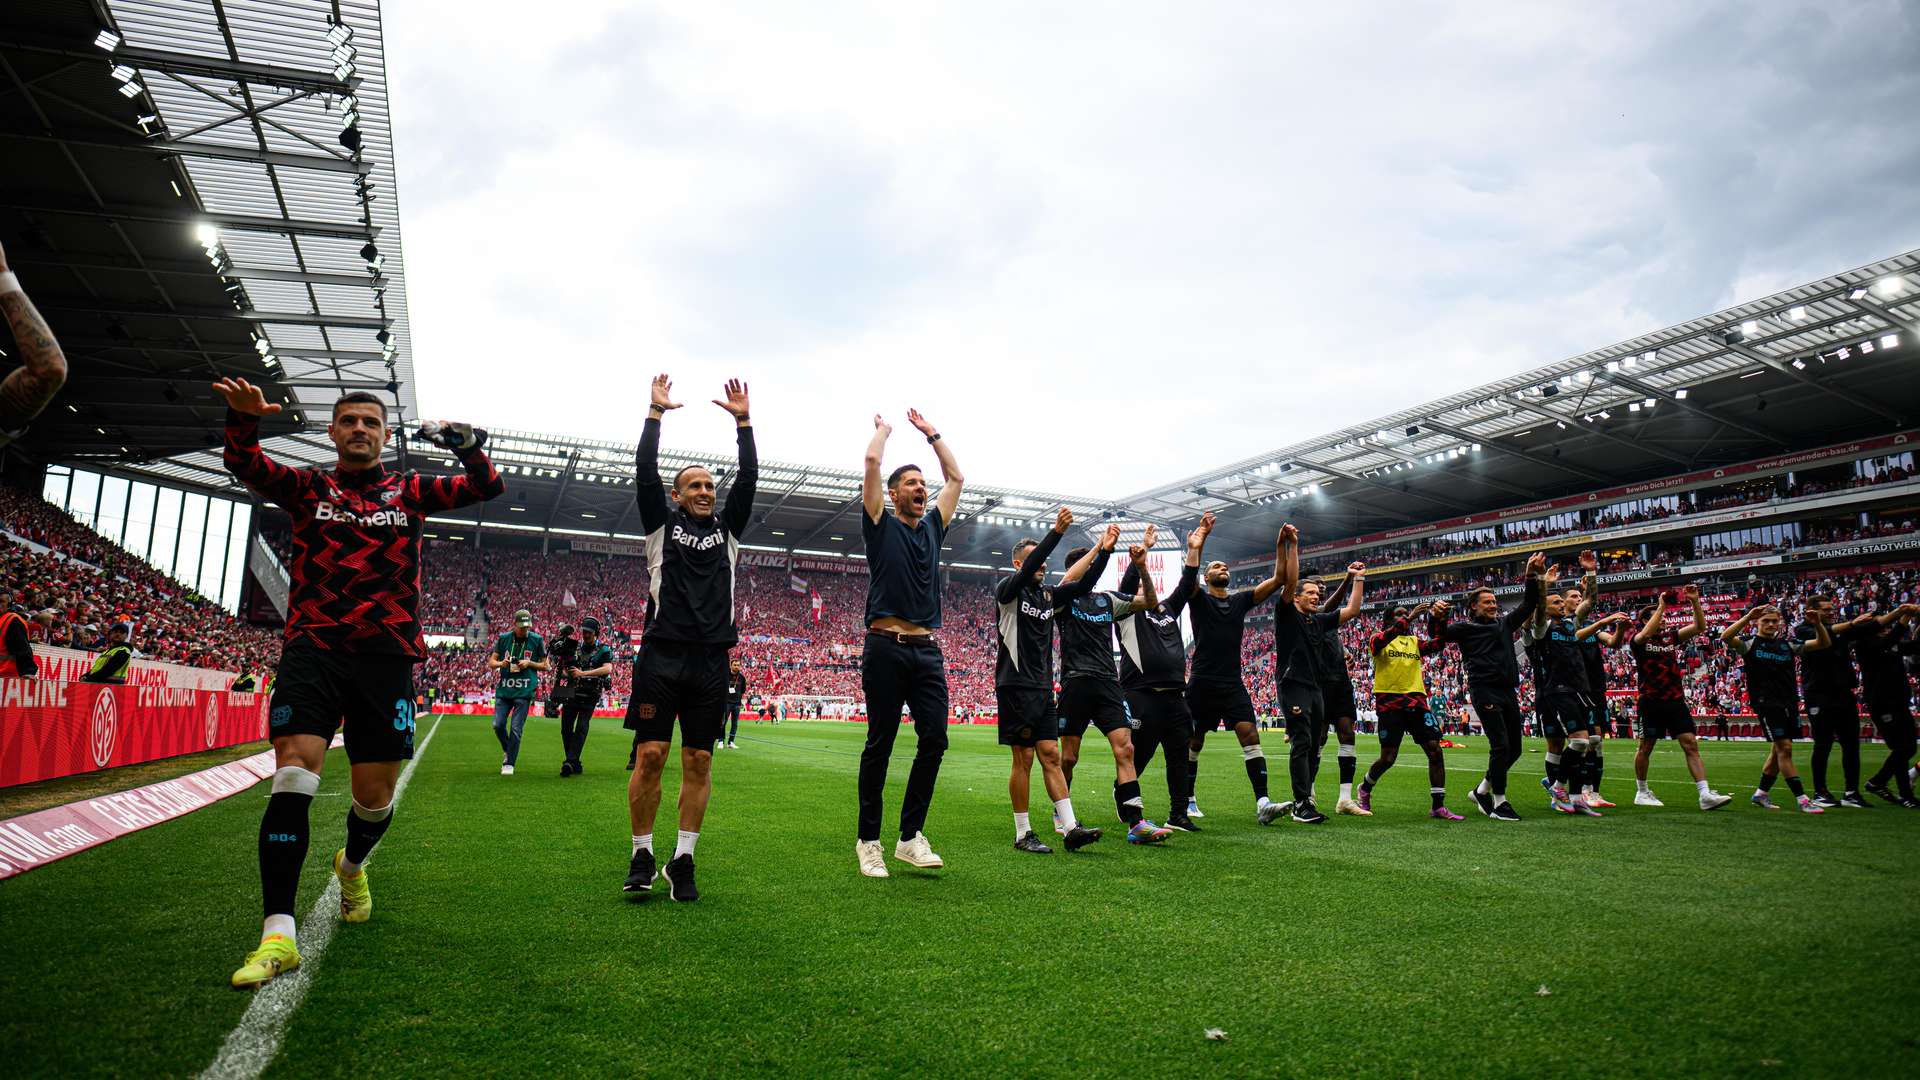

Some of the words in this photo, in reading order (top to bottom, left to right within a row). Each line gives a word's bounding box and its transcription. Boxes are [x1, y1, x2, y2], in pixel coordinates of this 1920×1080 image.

[1756, 445, 1861, 470] www.gemuenden-bau.de
[315, 501, 408, 527] Bamenia
[739, 553, 787, 567] MAINZ
[1817, 547, 1860, 559] MAINZER
[1606, 571, 1652, 585] STADTWERKE
